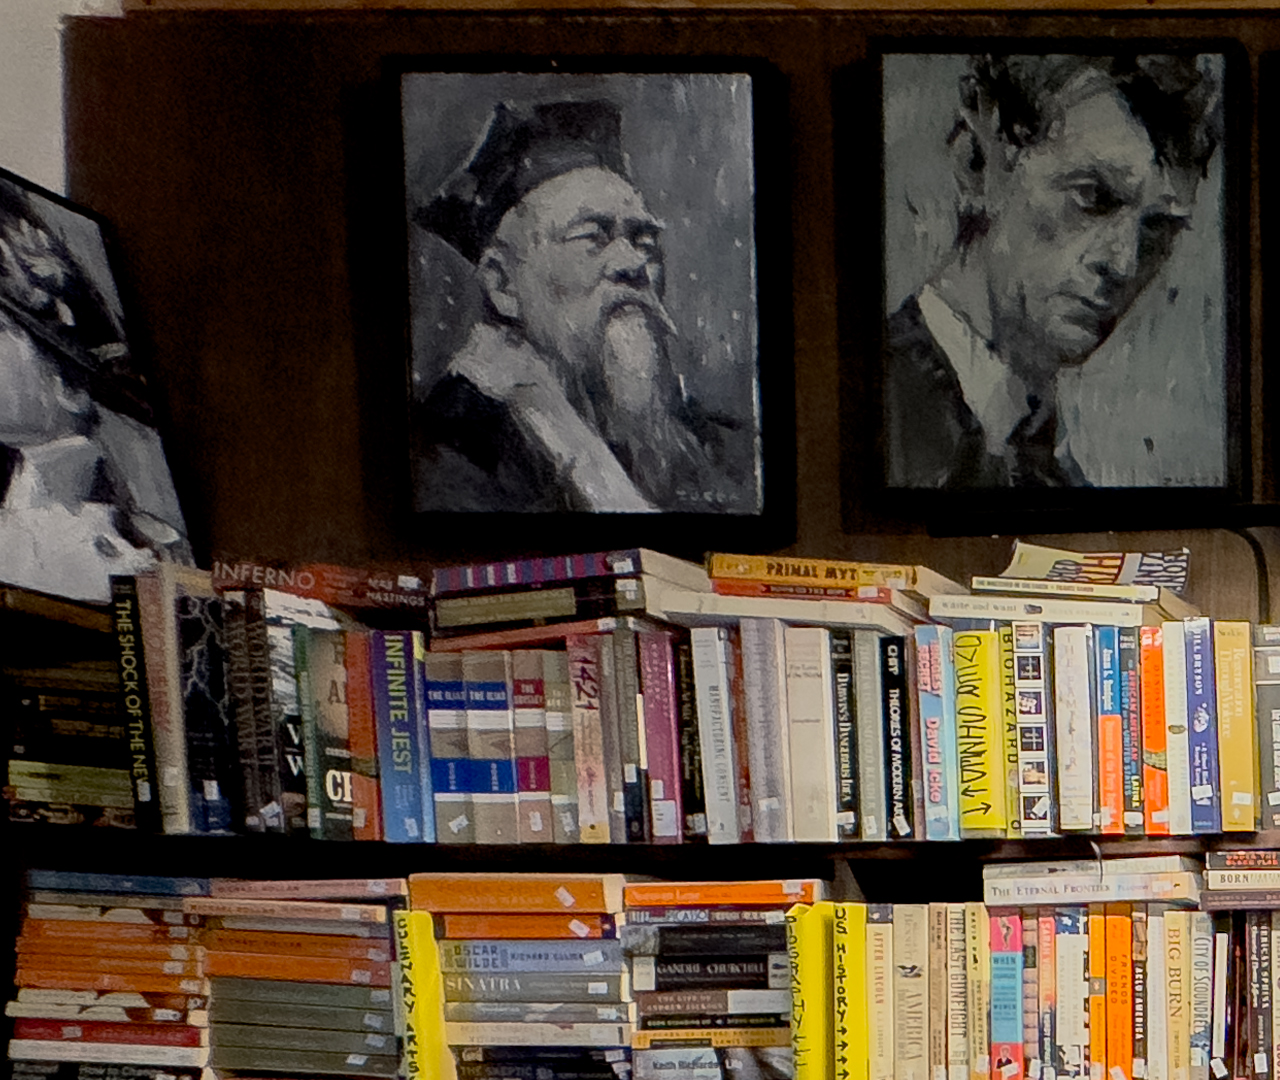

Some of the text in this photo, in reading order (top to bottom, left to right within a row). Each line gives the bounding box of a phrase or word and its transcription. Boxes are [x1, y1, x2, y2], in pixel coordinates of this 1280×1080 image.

[213, 561, 316, 591] INFERNO
[384, 634, 412, 775] INFINITE JEST
[927, 717, 945, 803] David Icke
[991, 882, 1111, 897] THE ETERNAL FRONTIER
[1219, 874, 1249, 884] BORN
[446, 975, 521, 991] SINATRA
[454, 945, 498, 957] OSCAR
[834, 943, 849, 1031] HISTORY
[874, 931, 884, 1005] AFTER LINCOLN
[949, 909, 967, 1039] THE LAST GUNFIGHT
[1165, 927, 1183, 1020] BIG BURN
[905, 990, 923, 1060] AMERICA
